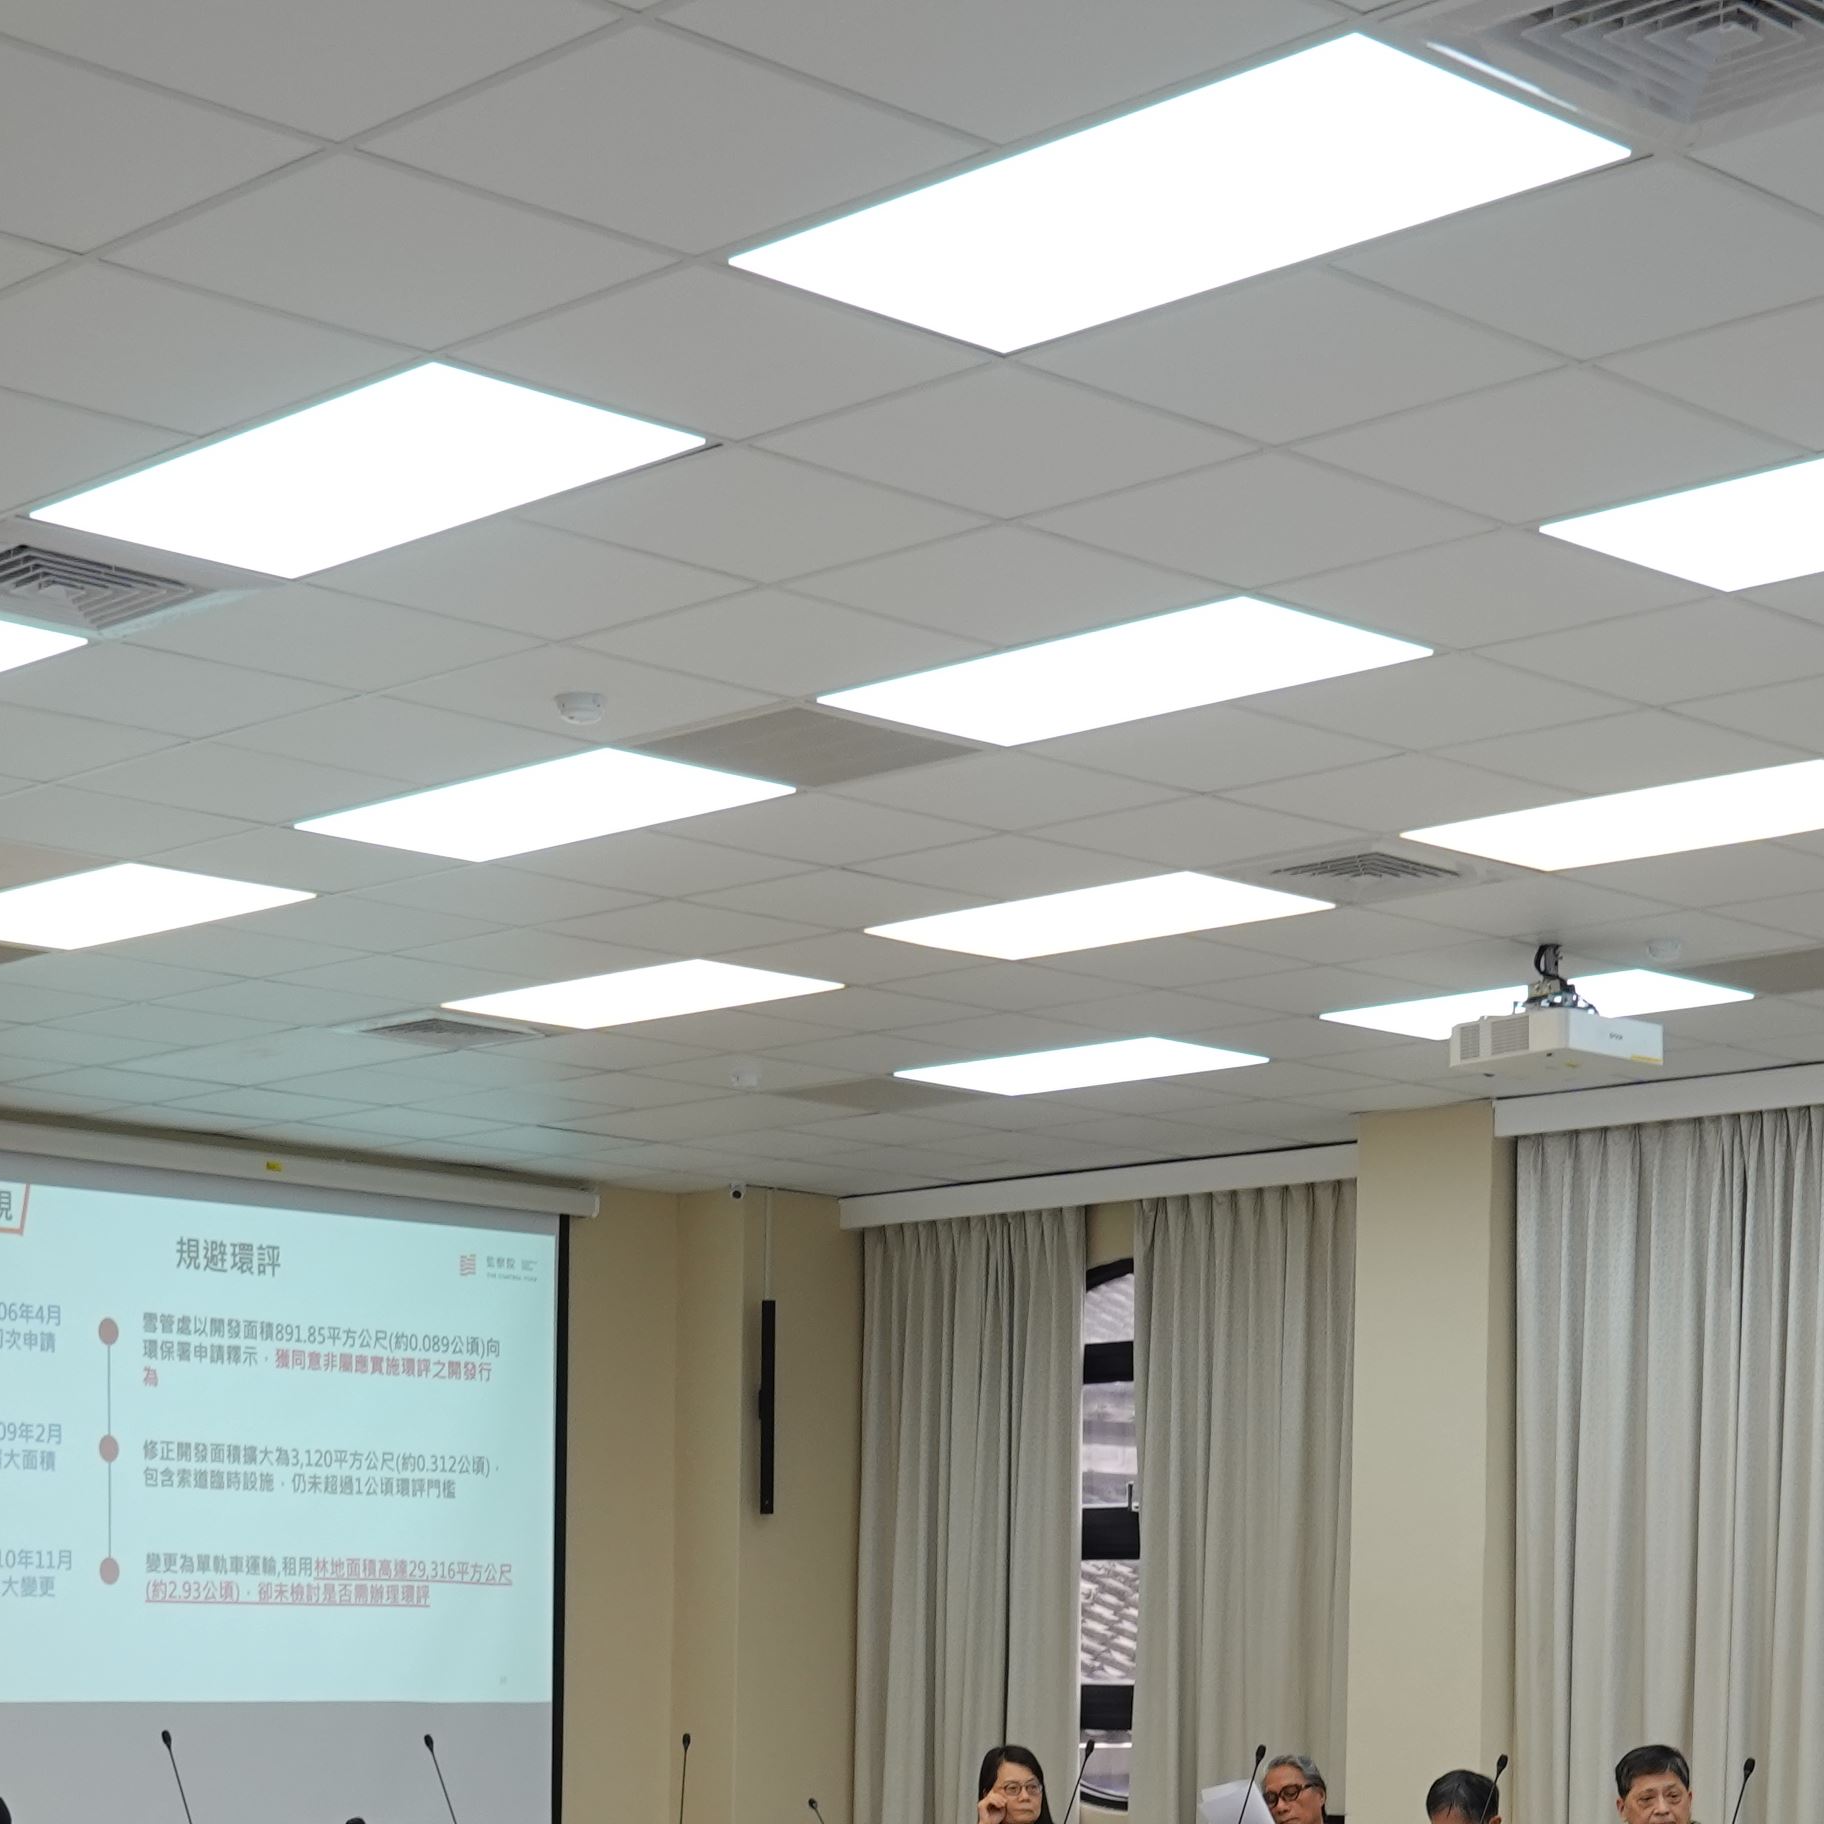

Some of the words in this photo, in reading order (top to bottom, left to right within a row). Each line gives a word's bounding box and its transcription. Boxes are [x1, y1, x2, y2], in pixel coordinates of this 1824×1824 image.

[176, 1236, 281, 1277] 規避環評
[143, 1366, 159, 1387] 為
